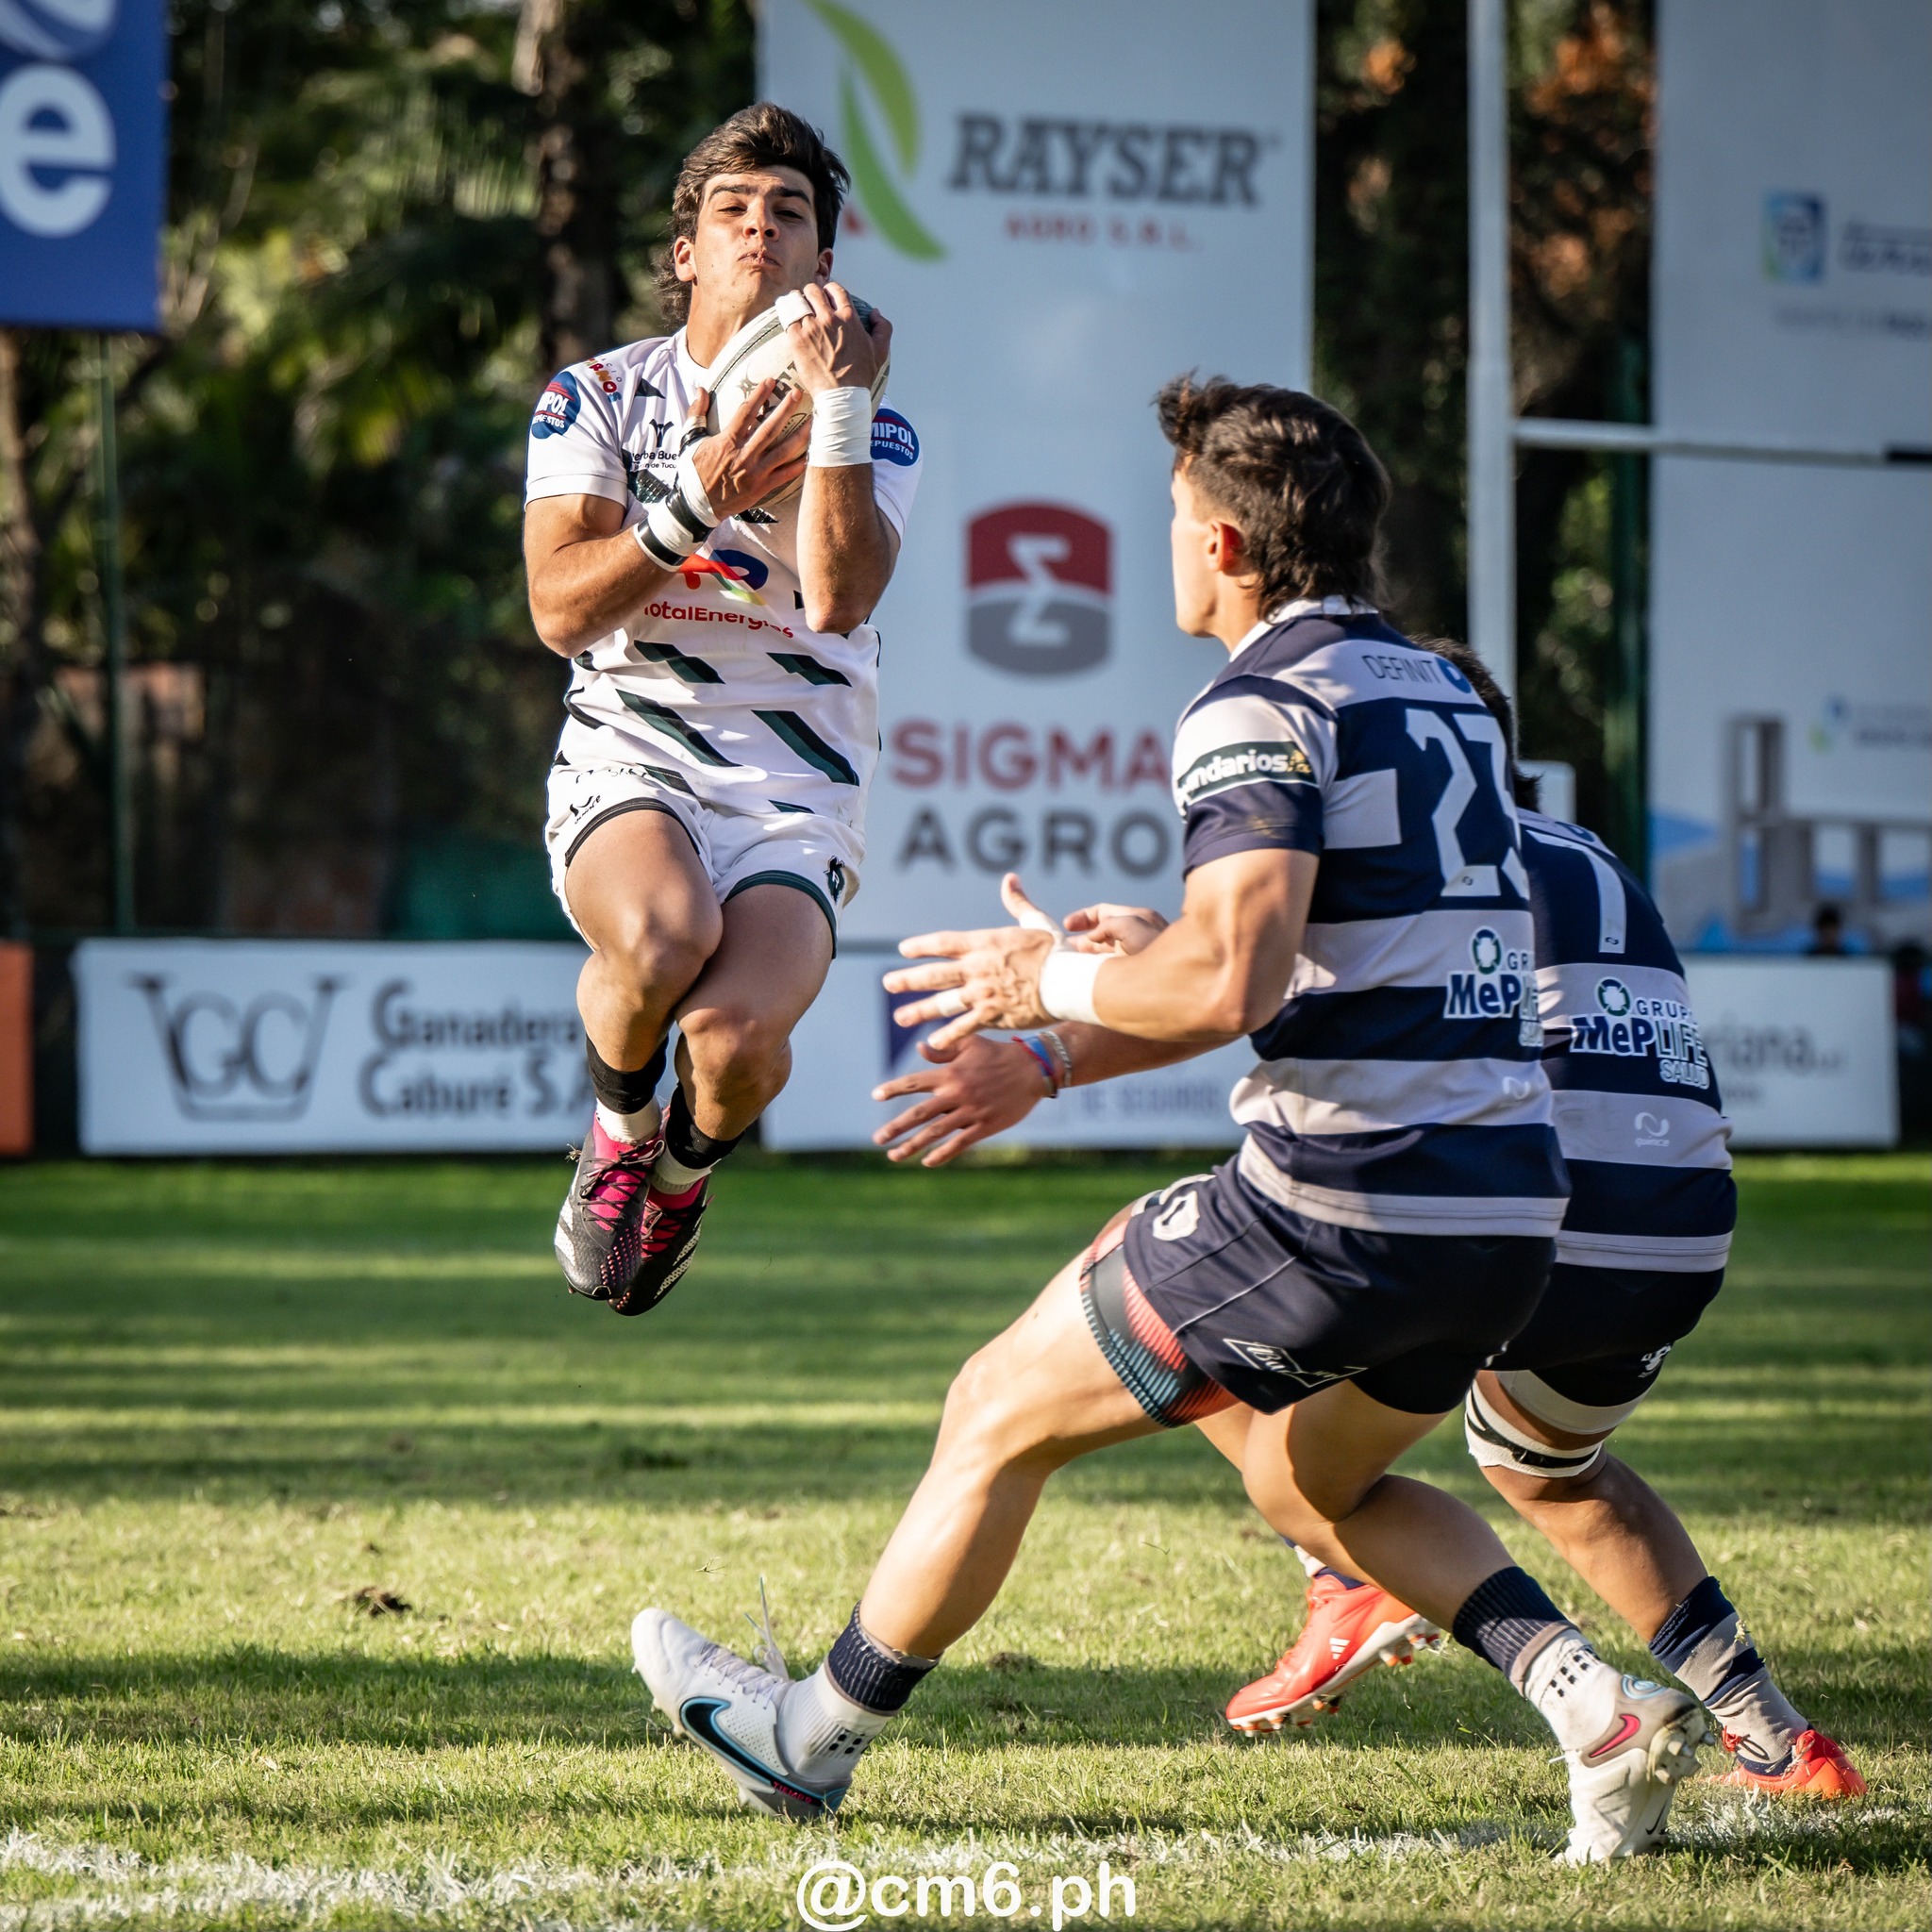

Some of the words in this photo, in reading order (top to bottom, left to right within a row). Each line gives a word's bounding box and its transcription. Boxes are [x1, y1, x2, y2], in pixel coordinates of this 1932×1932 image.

[947, 111, 1262, 208] RAYSER
[658, 450, 680, 460] Bue
[871, 440, 914, 460] EPUESTOS
[891, 720, 1172, 793] SIGMA
[896, 807, 1172, 880] AGRO
